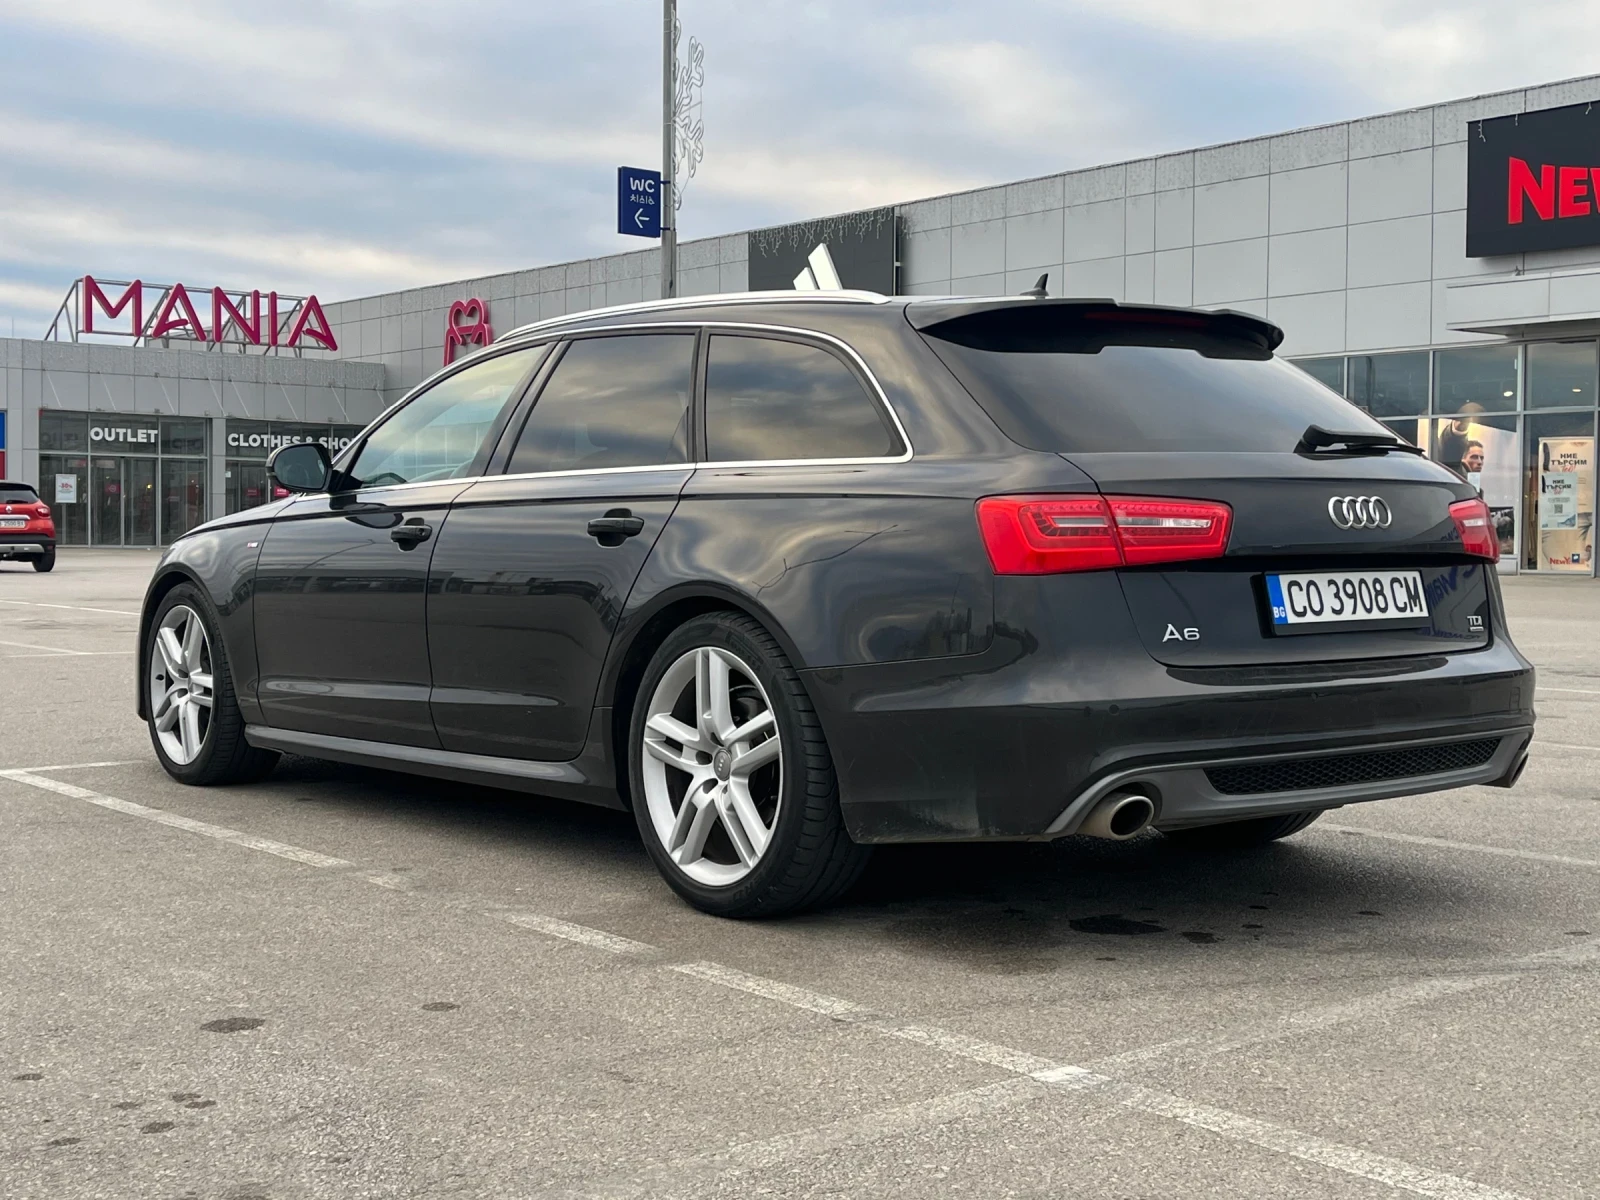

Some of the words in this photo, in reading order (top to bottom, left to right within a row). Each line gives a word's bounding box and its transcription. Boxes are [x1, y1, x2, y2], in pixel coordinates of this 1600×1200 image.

[630, 177, 655, 193] WC
[81, 275, 338, 351] MANIA
[90, 427, 158, 443] OUTLET
[227, 433, 301, 448] CLOTHES
[319, 436, 354, 450] SHO
[1287, 579, 1325, 618] CO
[1327, 577, 1389, 616] 3908
[1390, 576, 1424, 613] CM
[1273, 606, 1286, 618] BG
[1466, 615, 1483, 626] TDI
[1162, 623, 1200, 642] A6
